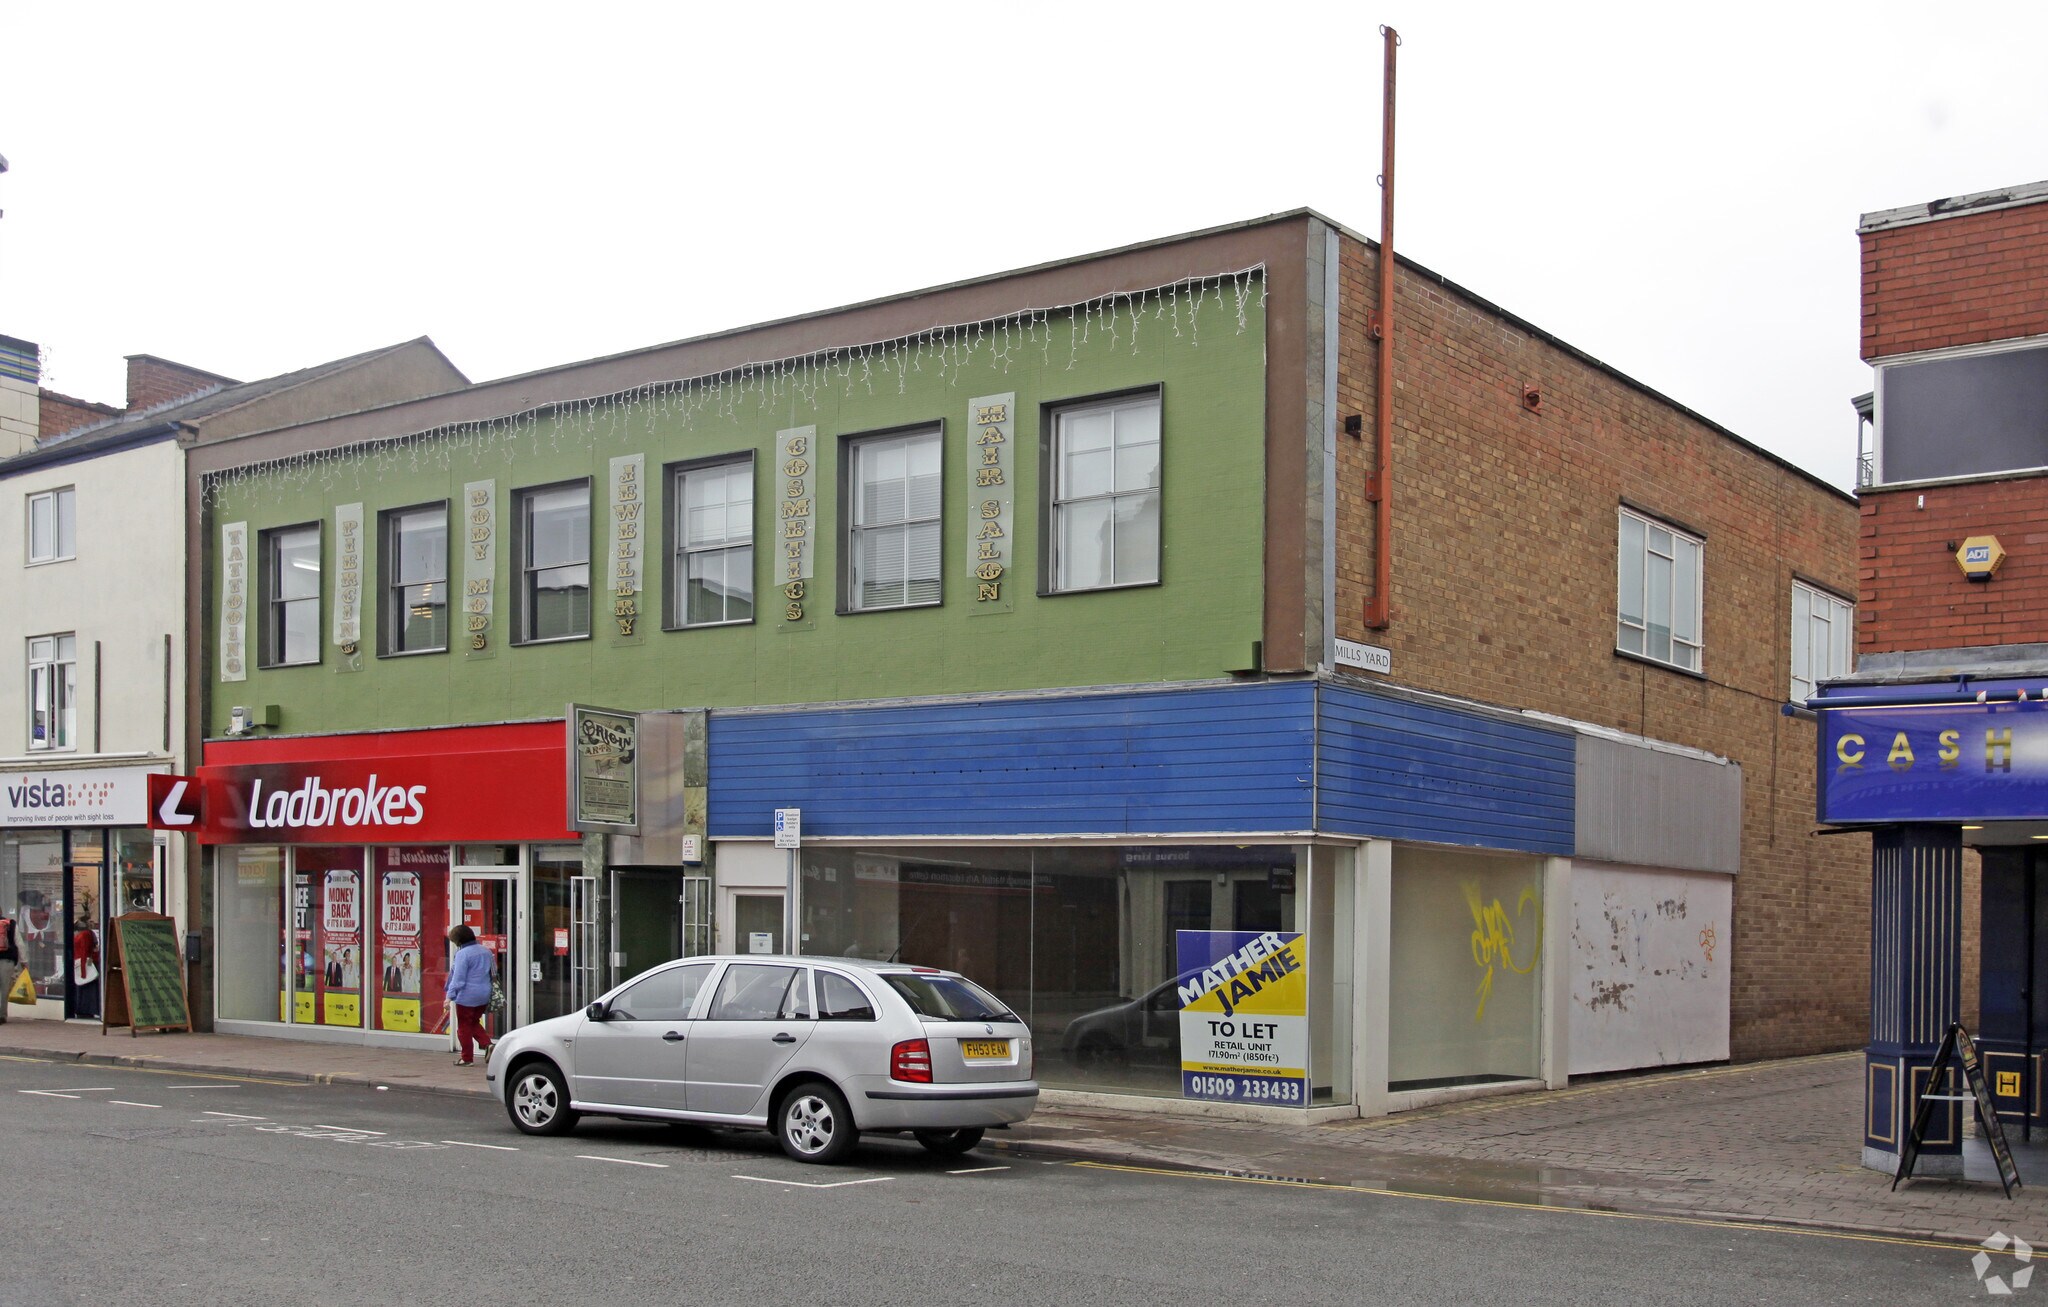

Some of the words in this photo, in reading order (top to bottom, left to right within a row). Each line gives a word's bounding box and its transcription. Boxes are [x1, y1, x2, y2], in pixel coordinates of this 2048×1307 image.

[975, 404, 1007, 486] HAIR
[470, 489, 491, 561] BODY
[781, 436, 810, 622] COSMETICS
[614, 464, 643, 636] JEWELLERY
[974, 500, 1004, 602] SALON
[1966, 549, 1990, 560] ADT
[340, 520, 358, 655] PIERCING
[225, 530, 244, 674] TATTOOING
[467, 578, 490, 651] MODS
[1335, 645, 1361, 662] MILLS
[1364, 651, 1389, 667] YARD
[1836, 727, 2012, 765] CASH
[8, 776, 65, 808] vista
[249, 774, 427, 828] Ladbrokes
[7, 815, 33, 823] Improving
[55, 814, 73, 822] people
[74, 813, 86, 821] with
[87, 813, 101, 822] sight
[328, 887, 354, 903] MONEY
[387, 889, 415, 906] MONEY
[464, 881, 482, 895] ATCH
[331, 903, 352, 919] BACK
[390, 906, 411, 922] BACK
[402, 923, 416, 931] DRAW
[1177, 932, 1287, 1007] MATHER
[1215, 947, 1301, 1018] JAMIE
[1207, 1020, 1235, 1037] TO
[1242, 1022, 1278, 1040] LET
[1214, 1040, 1245, 1050] RETAIL
[1248, 1043, 1272, 1052] UNIT
[1203, 1065, 1282, 1075] www.matherjamie.co.uk
[1191, 1075, 1235, 1096] 01509
[1242, 1079, 1299, 1100] 233433
[2000, 1073, 2016, 1093] H
